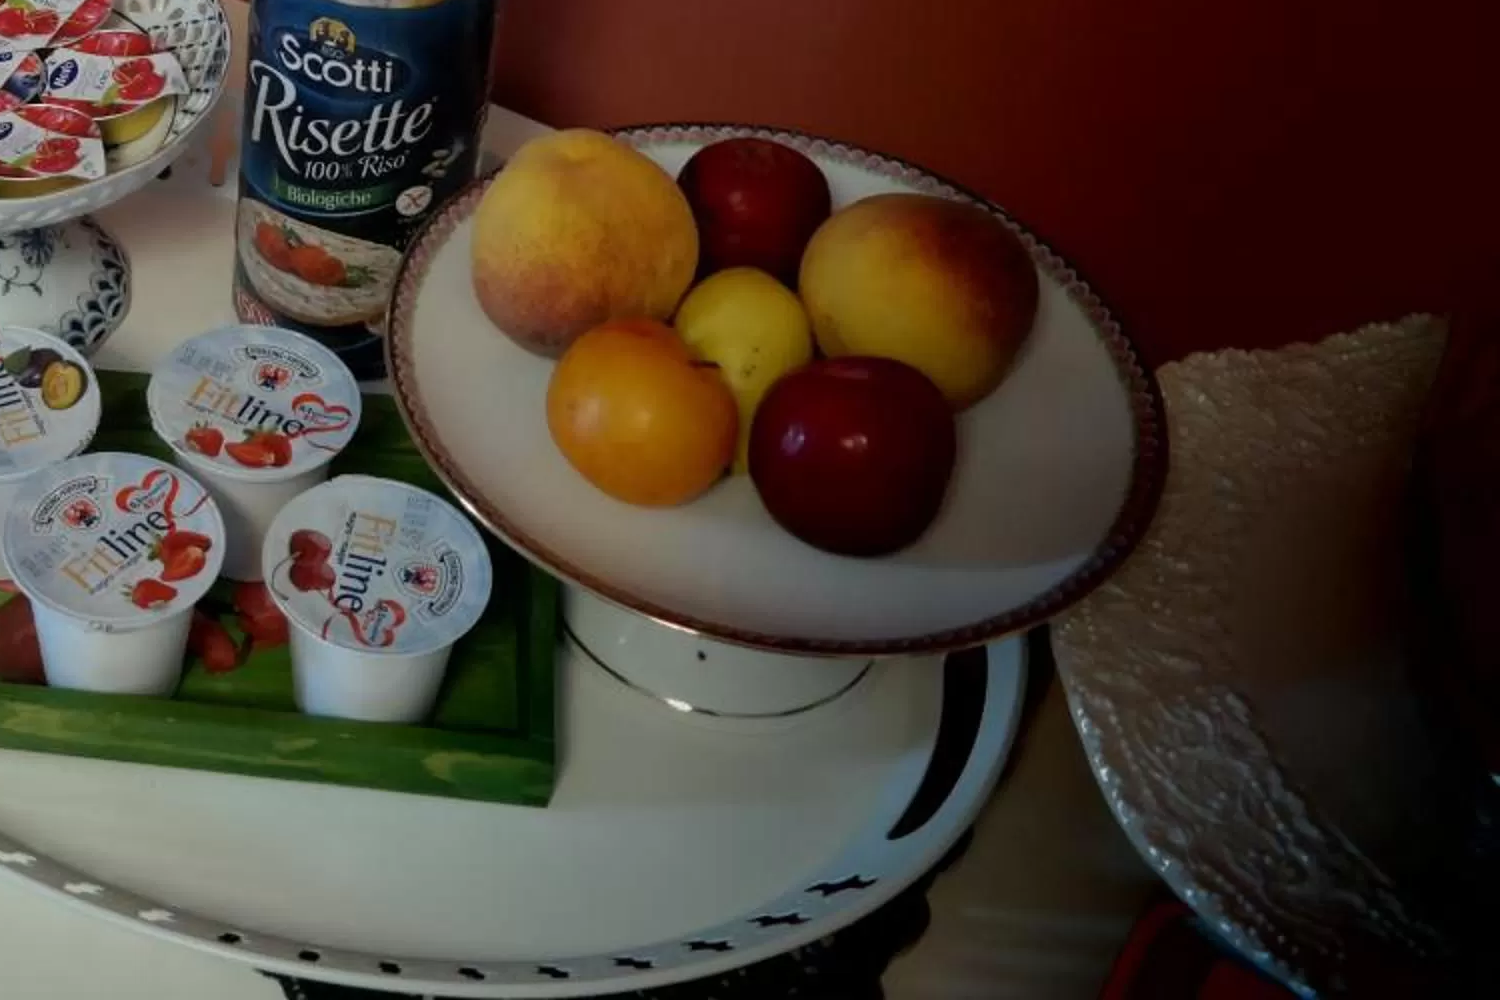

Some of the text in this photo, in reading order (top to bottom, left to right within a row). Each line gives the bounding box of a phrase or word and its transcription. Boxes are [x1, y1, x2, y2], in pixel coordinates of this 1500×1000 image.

[53, 59, 77, 87] Hero
[280, 33, 393, 94] Scotti
[249, 59, 433, 174] Risette
[358, 154, 406, 179] Riso
[287, 187, 373, 210] Biologiche
[61, 510, 171, 596] Fitline
[336, 512, 397, 613] Fitline
